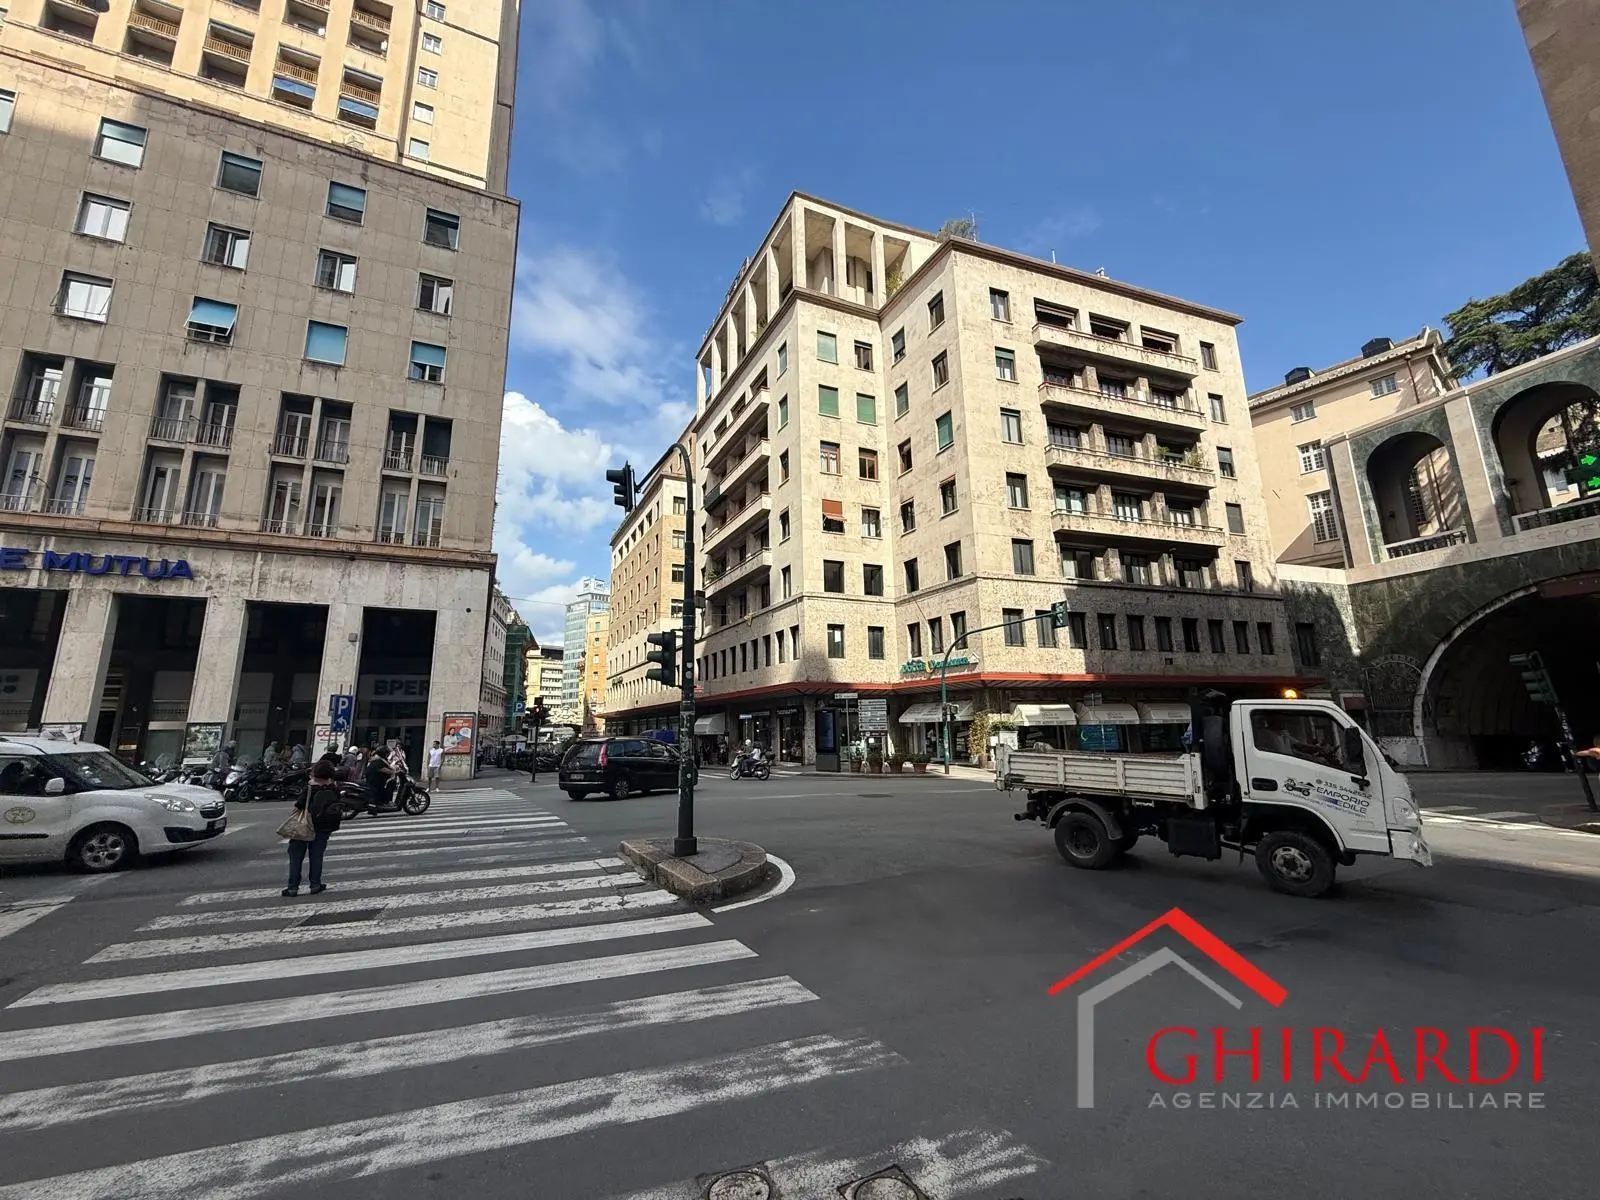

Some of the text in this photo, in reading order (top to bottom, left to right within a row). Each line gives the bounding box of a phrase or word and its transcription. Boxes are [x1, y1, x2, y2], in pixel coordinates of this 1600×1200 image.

[43, 550, 194, 580] MUTUA
[337, 697, 349, 715] P
[1316, 786, 1370, 807] EMPORIO
[1337, 799, 1368, 814] EDILE
